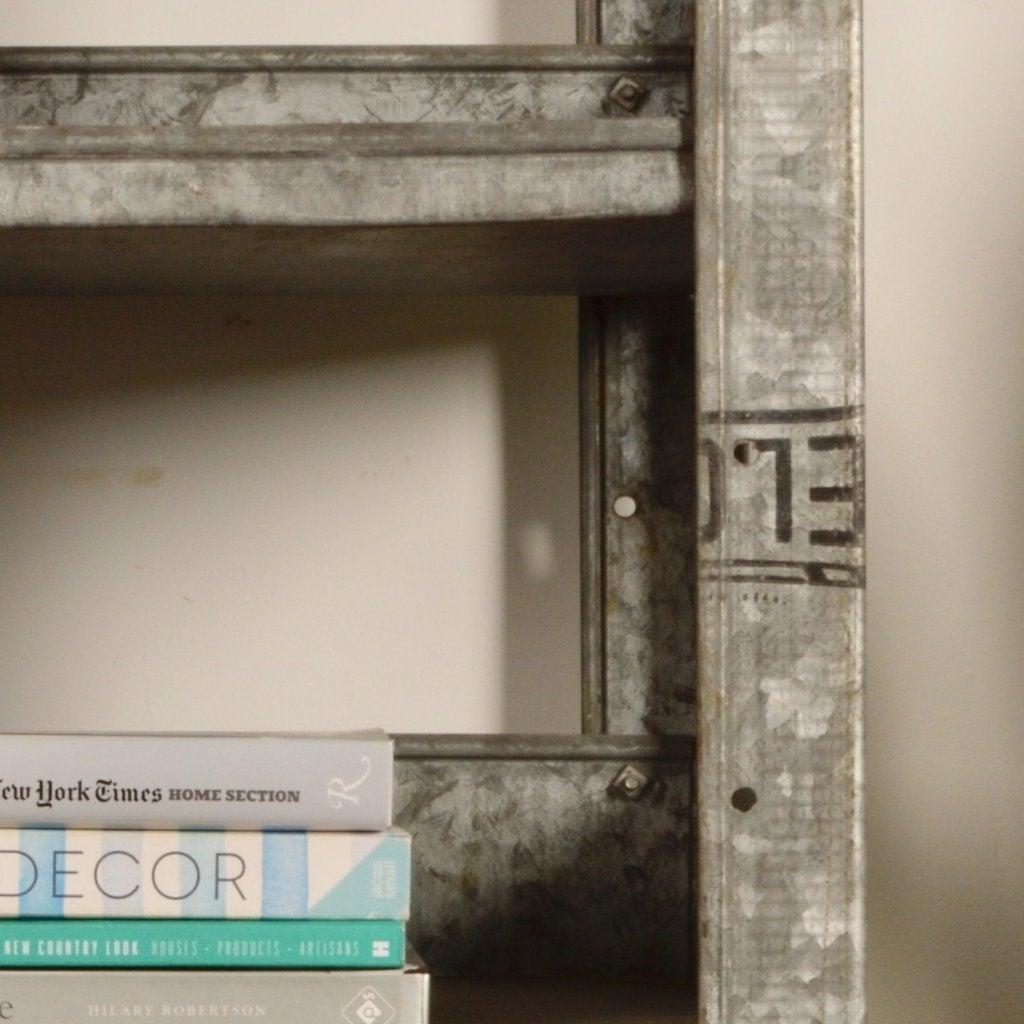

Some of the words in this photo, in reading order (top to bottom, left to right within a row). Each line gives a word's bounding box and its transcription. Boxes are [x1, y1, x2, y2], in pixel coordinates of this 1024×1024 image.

[36, 780, 90, 808] York
[95, 780, 163, 803] Times
[168, 788, 222, 802] HOME
[225, 789, 300, 802] SECTION
[4, 940, 30, 956] NEW
[38, 940, 98, 956] COUNTRY
[105, 940, 139, 956] LOOK
[151, 940, 198, 956] HOUSES
[217, 940, 280, 956] PRODUCTS
[299, 940, 360, 957] ARTISANS
[88, 1004, 154, 1017] HILARY
[162, 1004, 267, 1018] ROBERTSON
